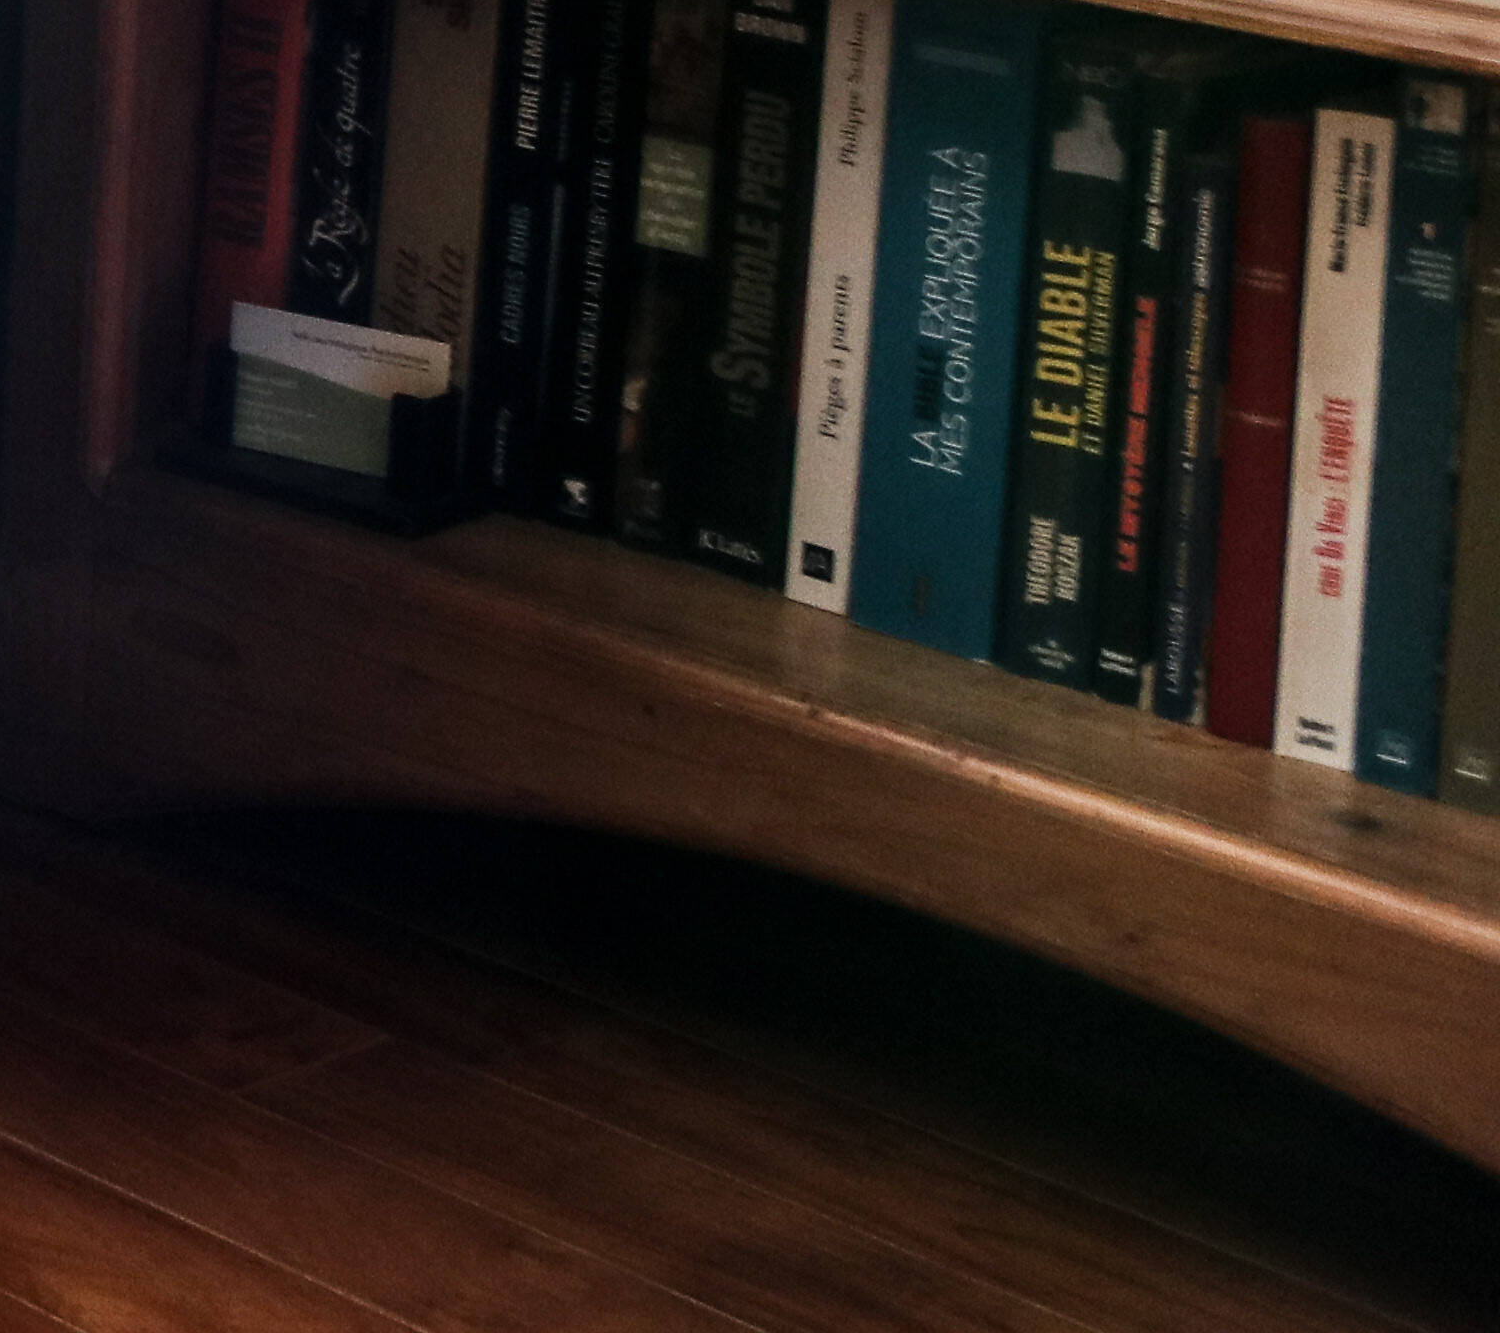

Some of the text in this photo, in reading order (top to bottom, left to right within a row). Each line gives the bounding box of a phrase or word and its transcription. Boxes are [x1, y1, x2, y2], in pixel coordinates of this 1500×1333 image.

[333, 41, 373, 133] quatre
[734, 12, 809, 44] BROWN
[314, 122, 355, 168] de
[516, 85, 543, 151] PIERRE
[307, 167, 368, 251] Règle
[499, 204, 533, 345] CADRES NOIRS
[709, 88, 791, 391] SYMBOLE PERDU
[816, 275, 851, 442] Pièges à parents
[908, 147, 960, 469] LA BIBLE EXPLIQUÉE À
[938, 151, 989, 475] MES CONTEMPORAINS
[1029, 240, 1092, 450] LE DIABLE
[1082, 250, 1117, 458] ET DANIEL SILVERMAN
[1165, 604, 1185, 694] LAROUSSE
